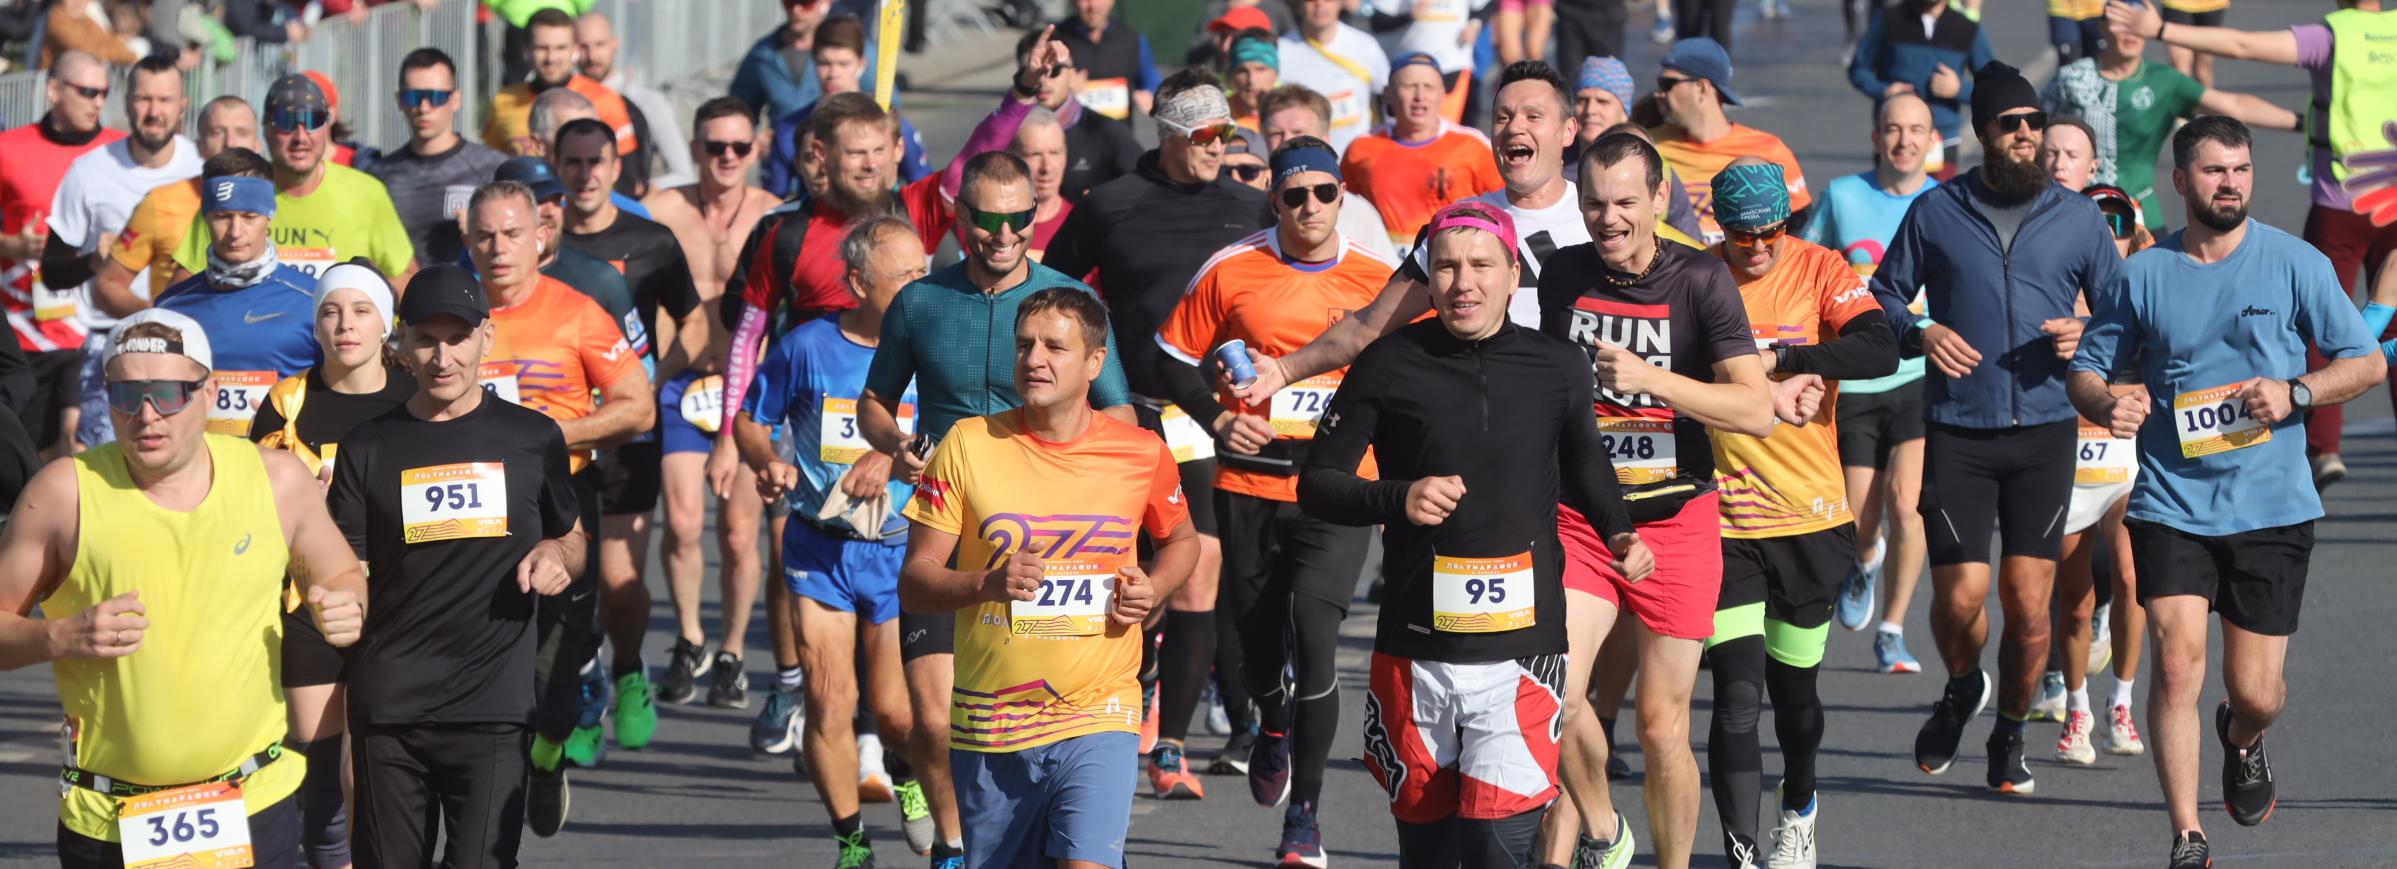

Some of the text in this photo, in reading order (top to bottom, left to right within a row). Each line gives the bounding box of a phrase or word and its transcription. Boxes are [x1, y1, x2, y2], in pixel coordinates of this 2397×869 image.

[1568, 309, 1672, 354] RUN
[1600, 435, 1655, 460] 248
[425, 482, 483, 513] 951
[1036, 578, 1094, 607] 274
[1465, 577, 1506, 605] 95
[146, 808, 220, 847] 365
